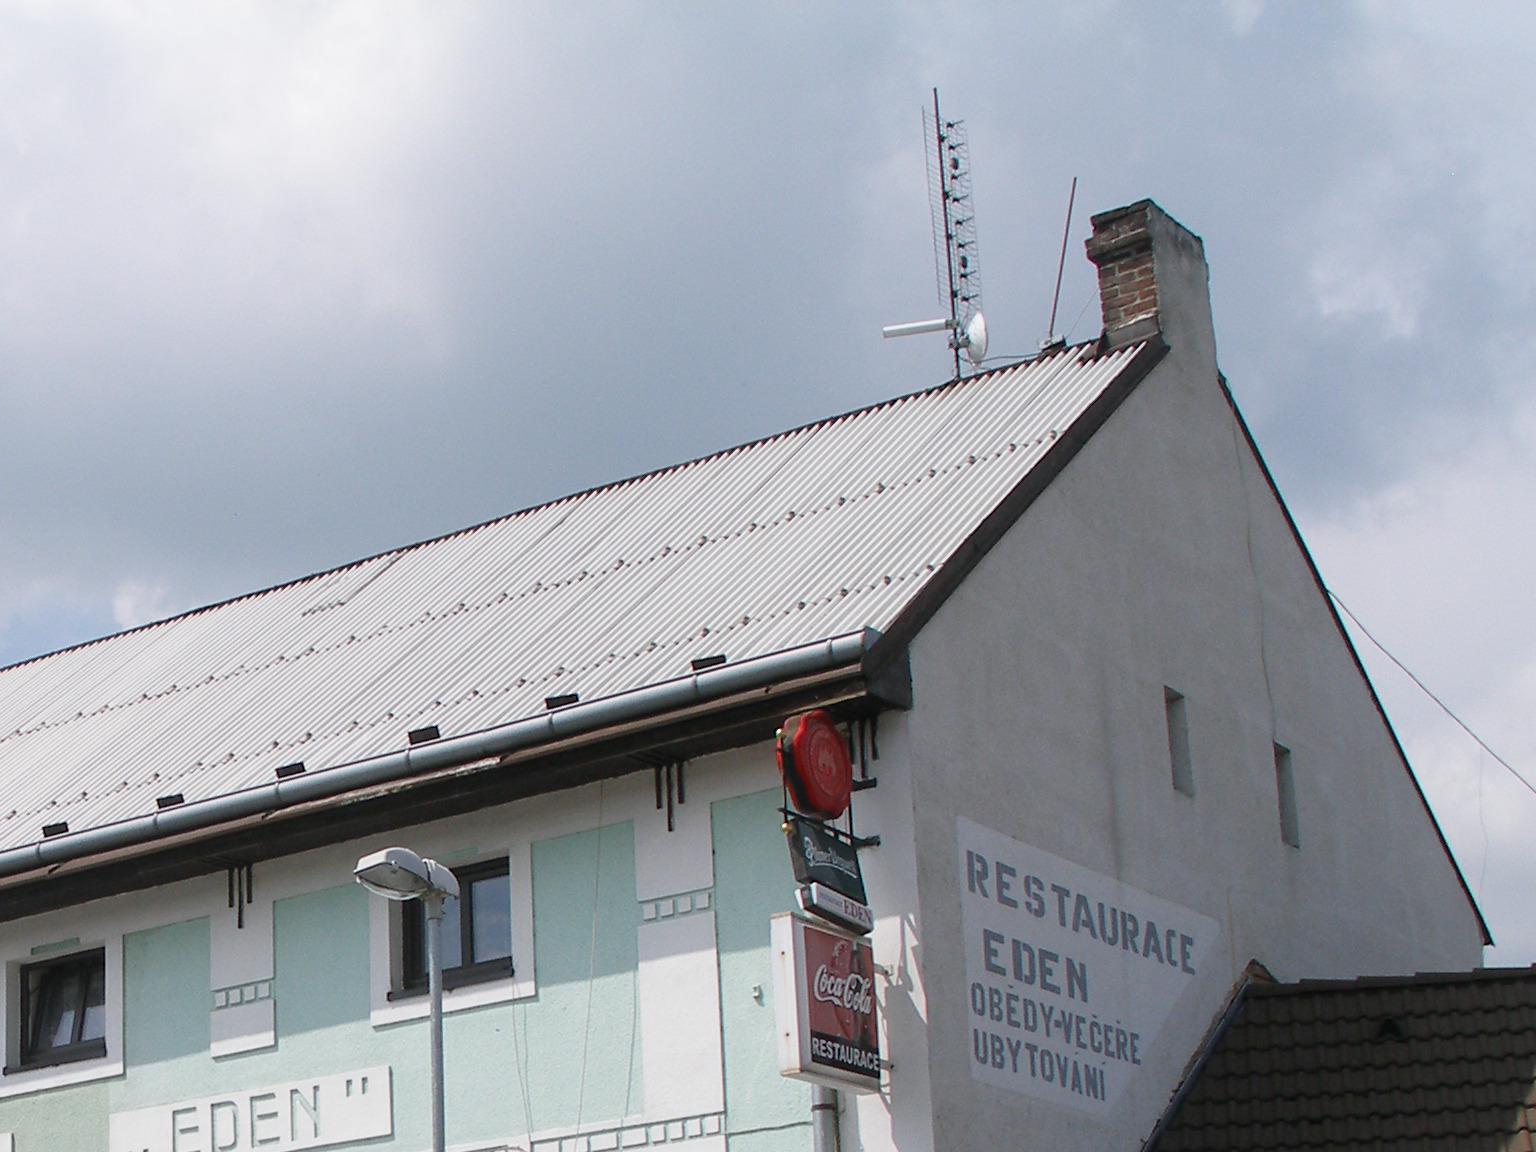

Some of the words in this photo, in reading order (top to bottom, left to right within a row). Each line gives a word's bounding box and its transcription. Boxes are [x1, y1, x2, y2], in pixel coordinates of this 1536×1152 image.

[843, 899, 872, 922] EDEN
[966, 850, 1196, 976] RESTAURACE
[982, 928, 1088, 1003] EDEN
[812, 1037, 880, 1071] RESTAURACE
[973, 1028, 1106, 1101] UBYTOVÁNÍ
